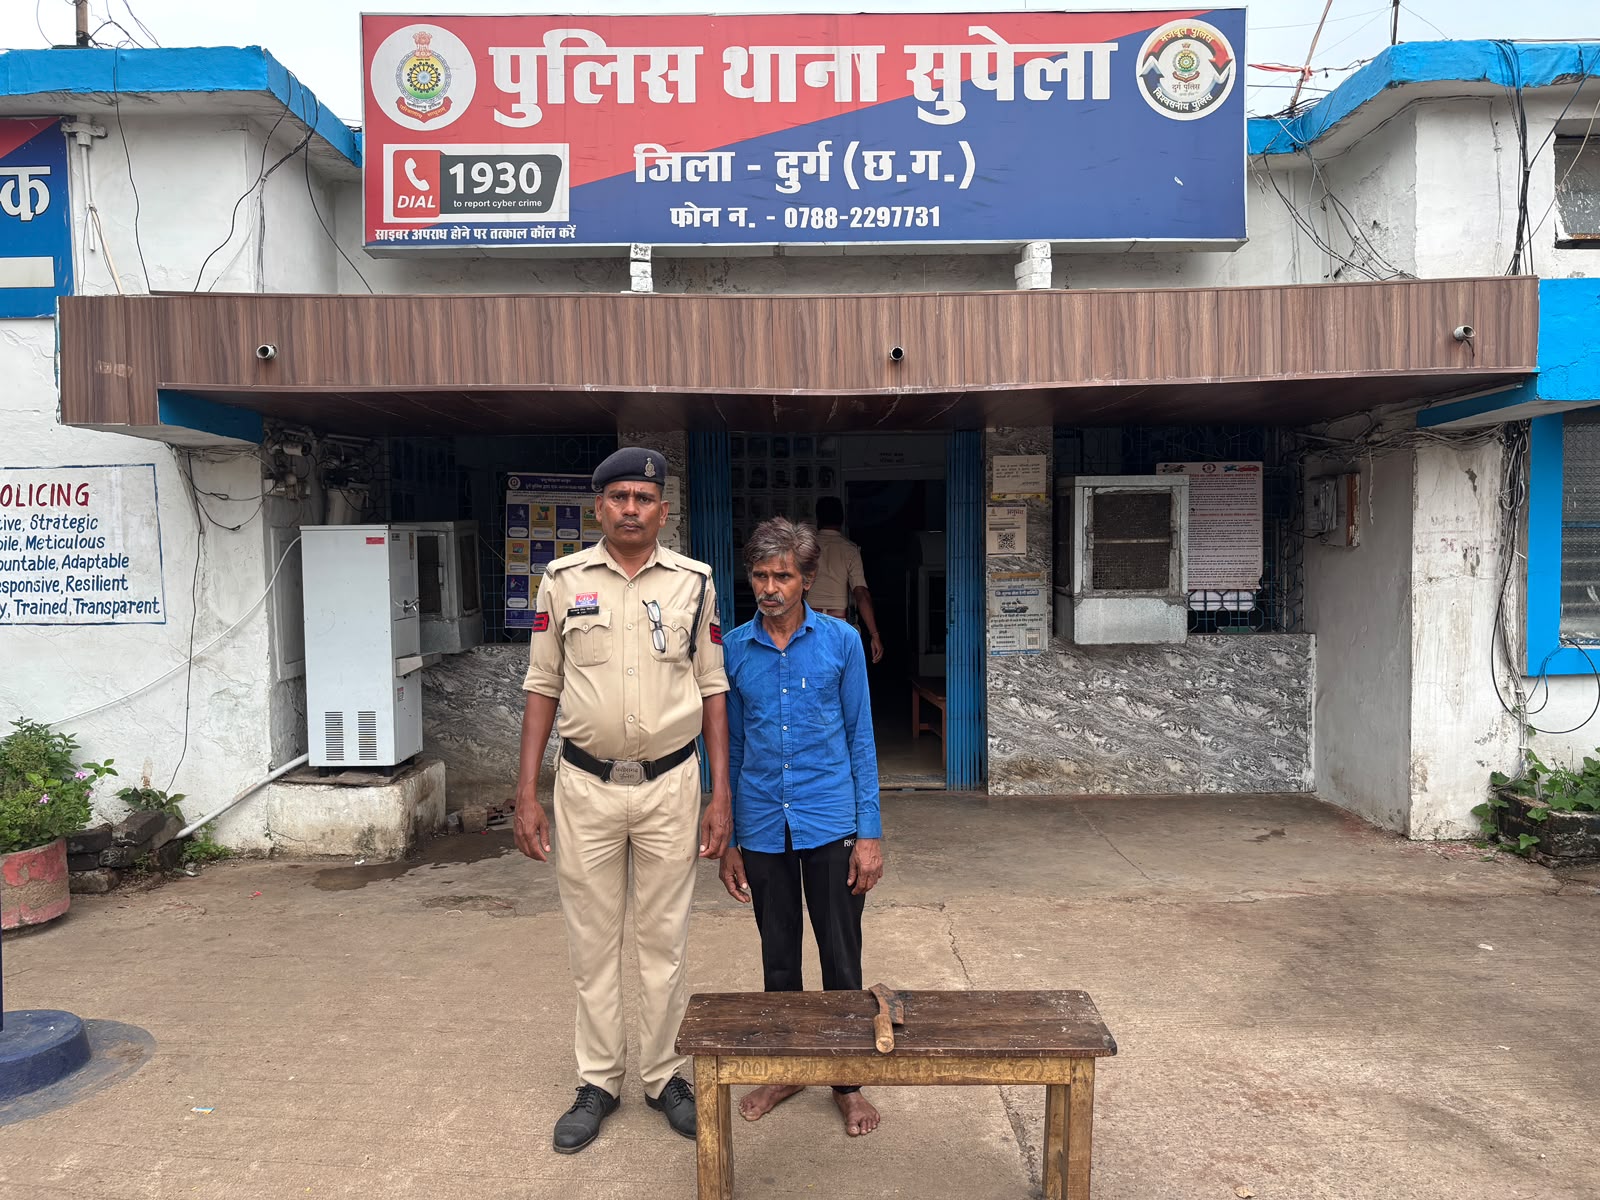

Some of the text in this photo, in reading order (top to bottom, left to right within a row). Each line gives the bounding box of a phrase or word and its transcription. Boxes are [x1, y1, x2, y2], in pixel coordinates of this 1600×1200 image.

[489, 26, 1119, 128] पुलिस थाना सुपेला
[633, 144, 736, 183] जिला
[775, 140, 833, 194] दुर्ग
[449, 162, 542, 195] 1930
[397, 195, 436, 209] DIAL
[453, 198, 543, 209] to report cyber crime
[670, 202, 722, 228] फोन
[727, 207, 756, 228] न.
[785, 205, 940, 230] 0788-2297731
[412, 228, 448, 240] अपराध
[451, 226, 471, 240] होने
[473, 228, 487, 239] पर
[490, 227, 528, 239] तत्काल
[530, 225, 556, 239] कॉल
[559, 225, 577, 239] करें
[0, 483, 90, 507] OLICING
[30, 513, 99, 533] Strategic
[26, 535, 105, 550] Meticulous
[61, 553, 130, 572] Adaptable
[65, 574, 129, 592] Resilient
[73, 597, 160, 619] Transparent
